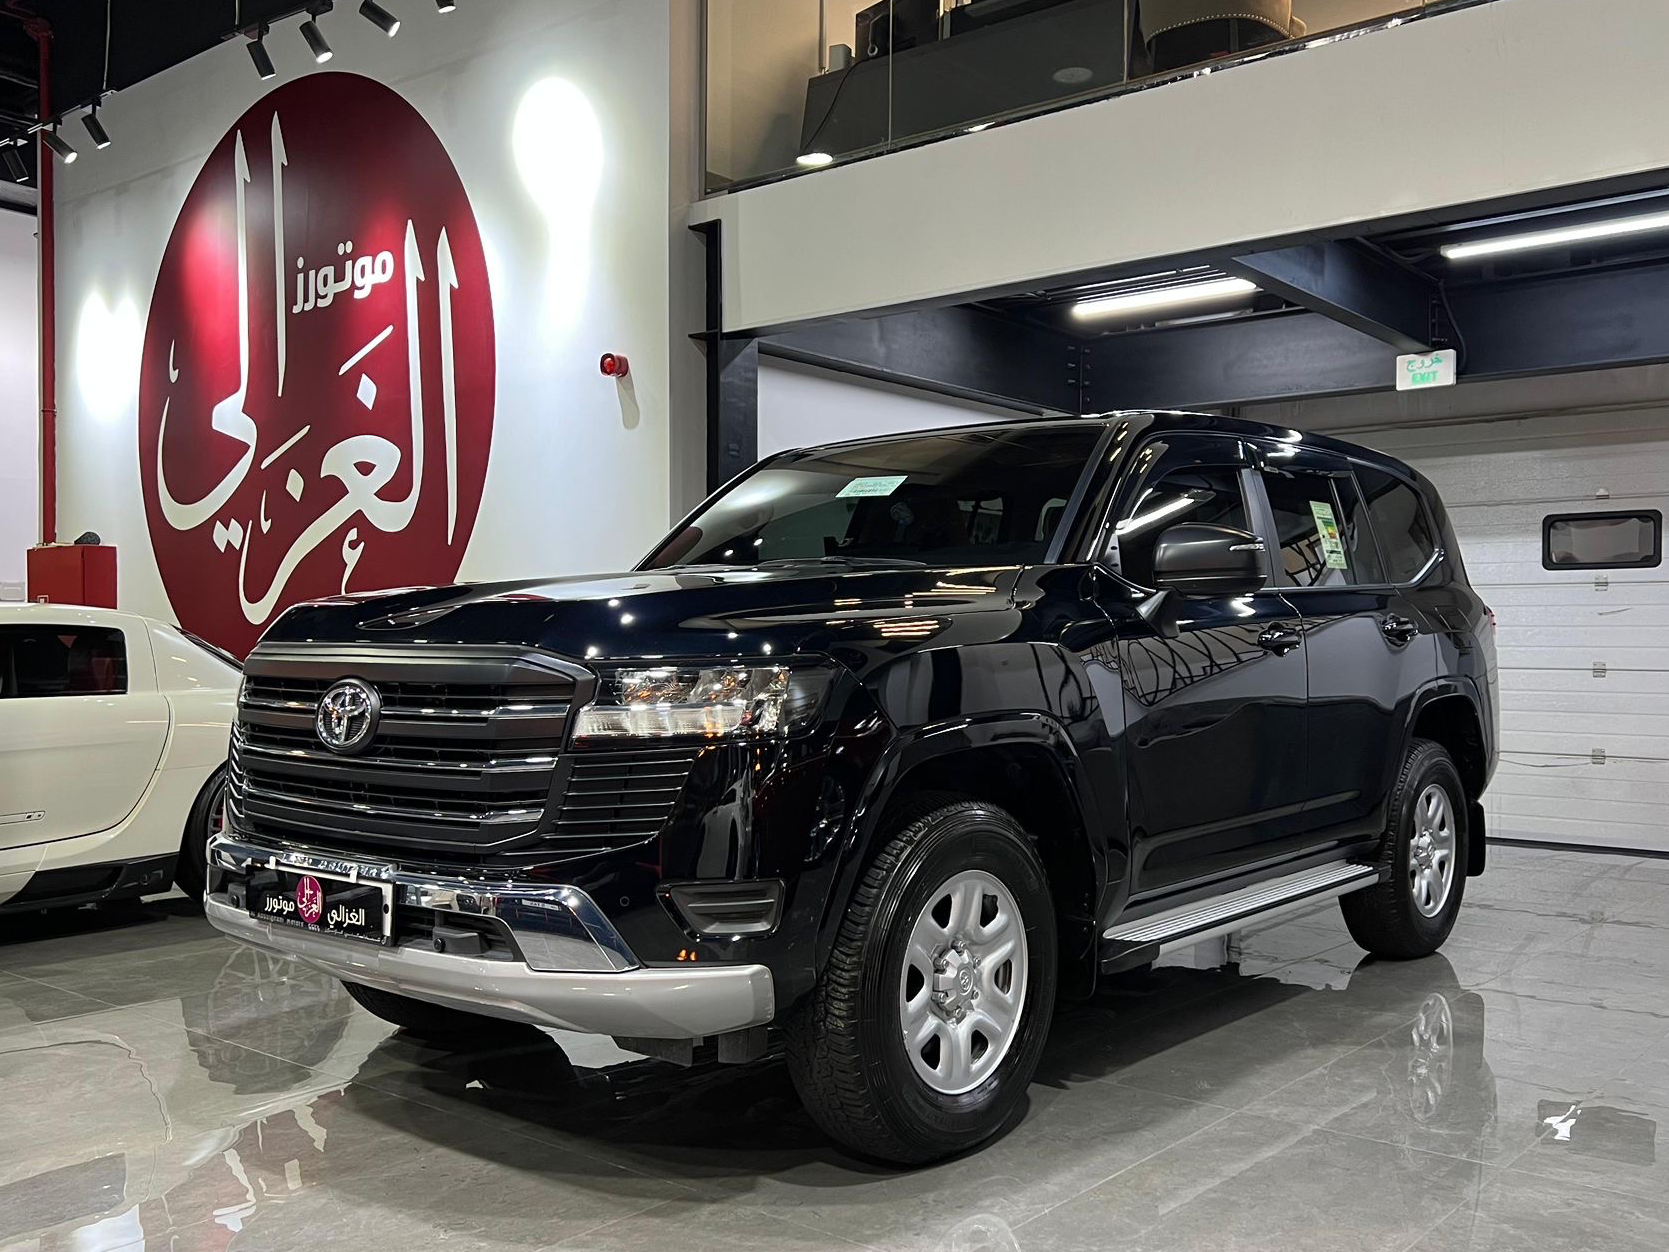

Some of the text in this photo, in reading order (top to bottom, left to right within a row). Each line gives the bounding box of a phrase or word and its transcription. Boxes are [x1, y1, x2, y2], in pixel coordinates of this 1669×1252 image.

[292, 241, 395, 314] موتورز
[1406, 353, 1443, 372] خروج
[1411, 371, 1439, 385] EXIT
[264, 893, 295, 915] موتورز
[327, 904, 366, 928] الغزالي
